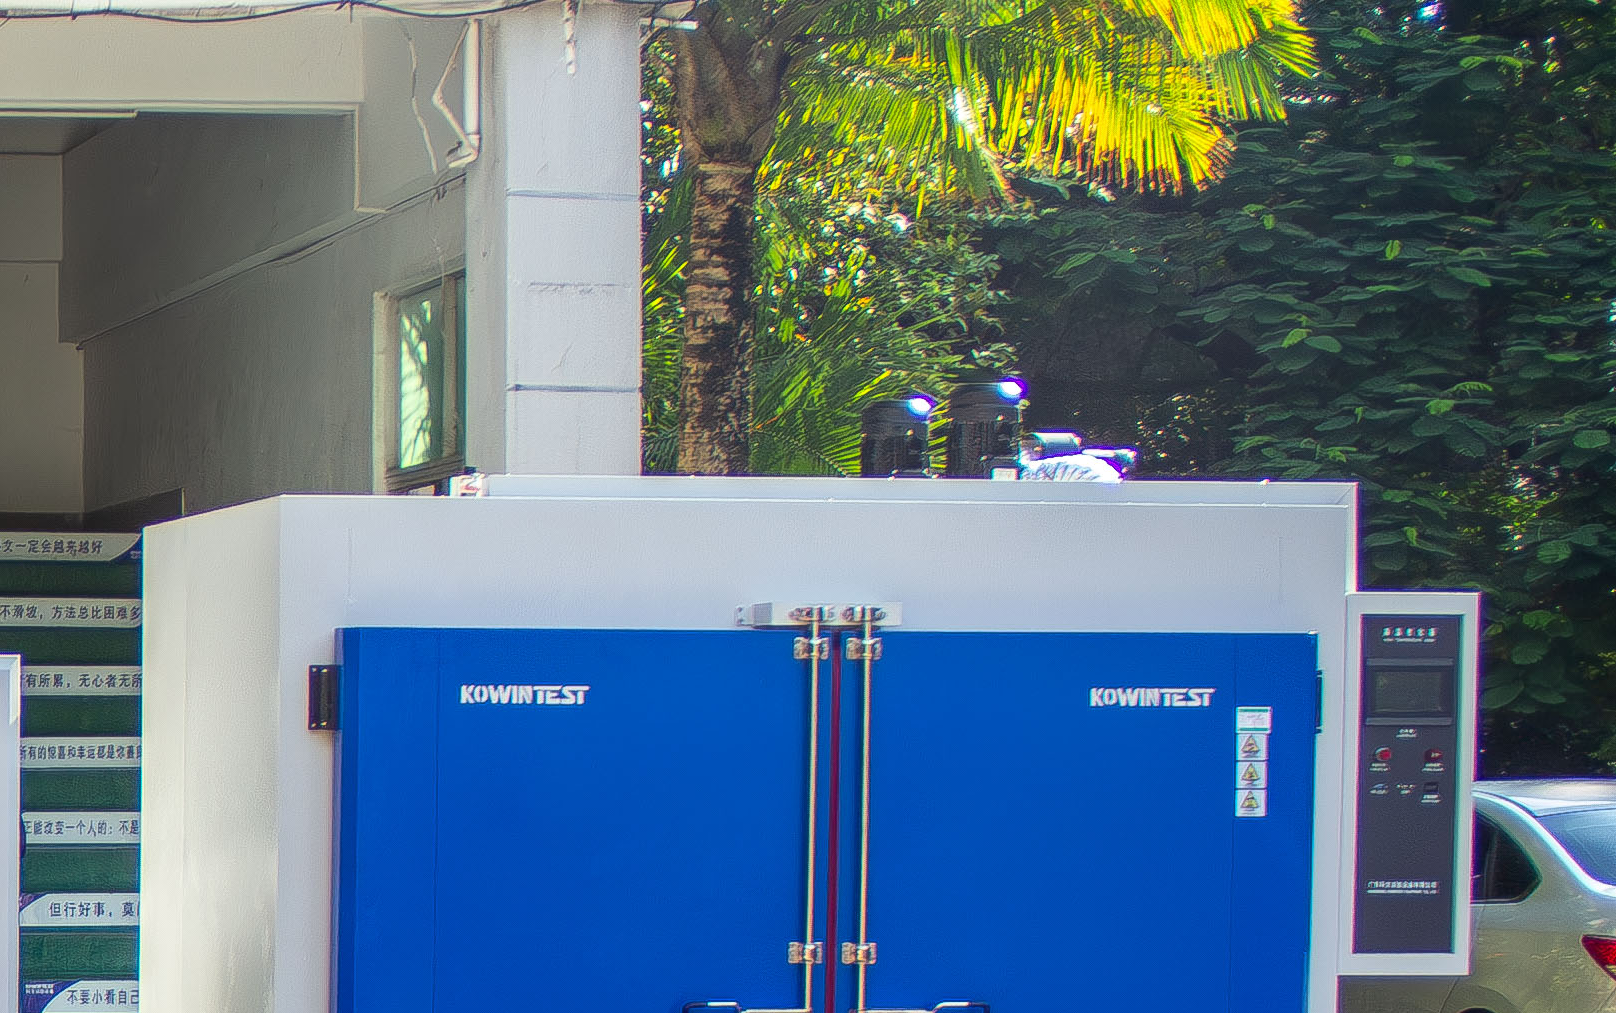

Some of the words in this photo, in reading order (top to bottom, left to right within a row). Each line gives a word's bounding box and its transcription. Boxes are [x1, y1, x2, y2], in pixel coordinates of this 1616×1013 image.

[460, 684, 591, 705] KOWINTEST
[1090, 687, 1216, 707] KOWINTEST
[49, 902, 140, 918] 但行好事，莫
